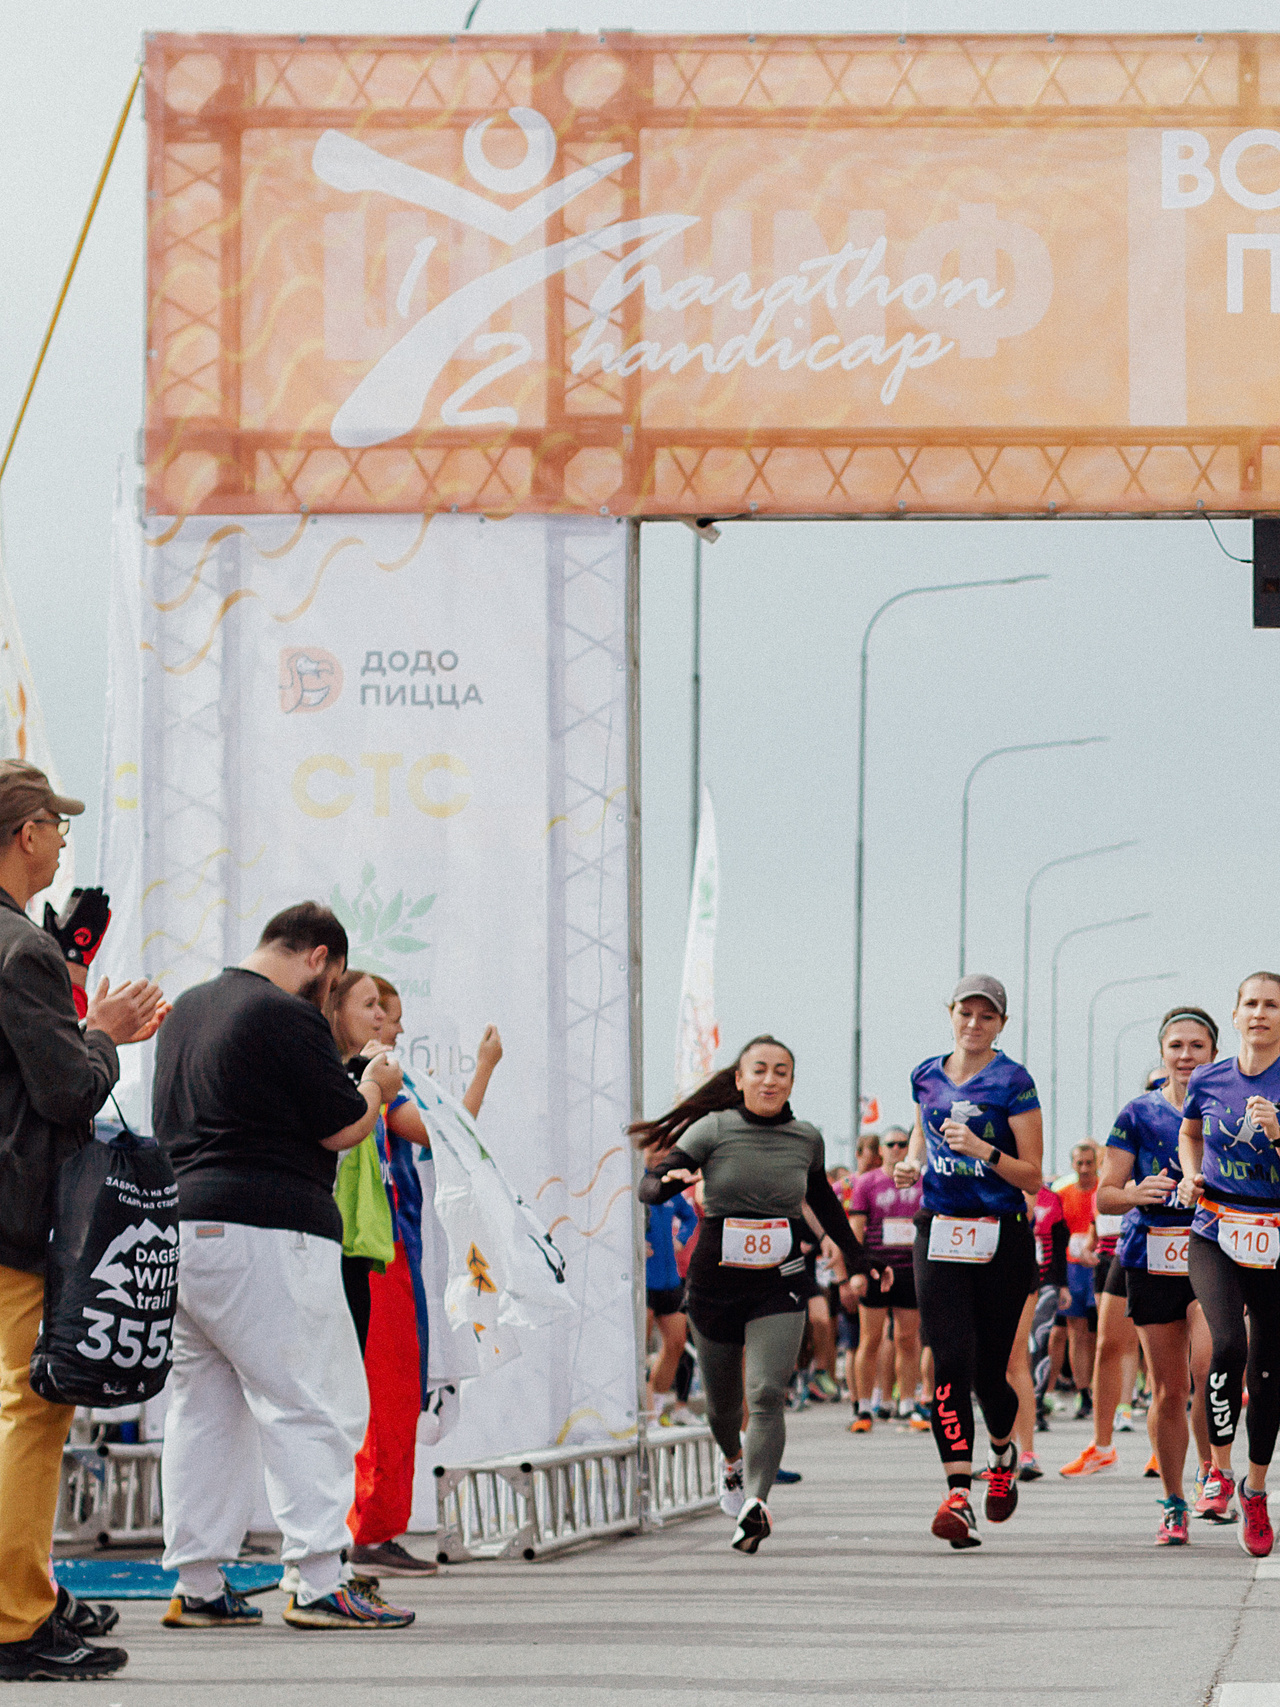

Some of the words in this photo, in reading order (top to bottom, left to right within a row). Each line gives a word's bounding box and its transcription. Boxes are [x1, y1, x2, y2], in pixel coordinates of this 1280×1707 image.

[360, 650, 459, 676] ДОДО
[360, 684, 484, 709] ПИЦЦА
[292, 753, 472, 819] СТС
[744, 1235, 771, 1254] 88
[950, 1227, 976, 1246] 51
[1230, 1230, 1269, 1253] 110
[133, 1265, 179, 1290] WIL
[136, 1290, 171, 1310] trail
[76, 1307, 174, 1369] 355
